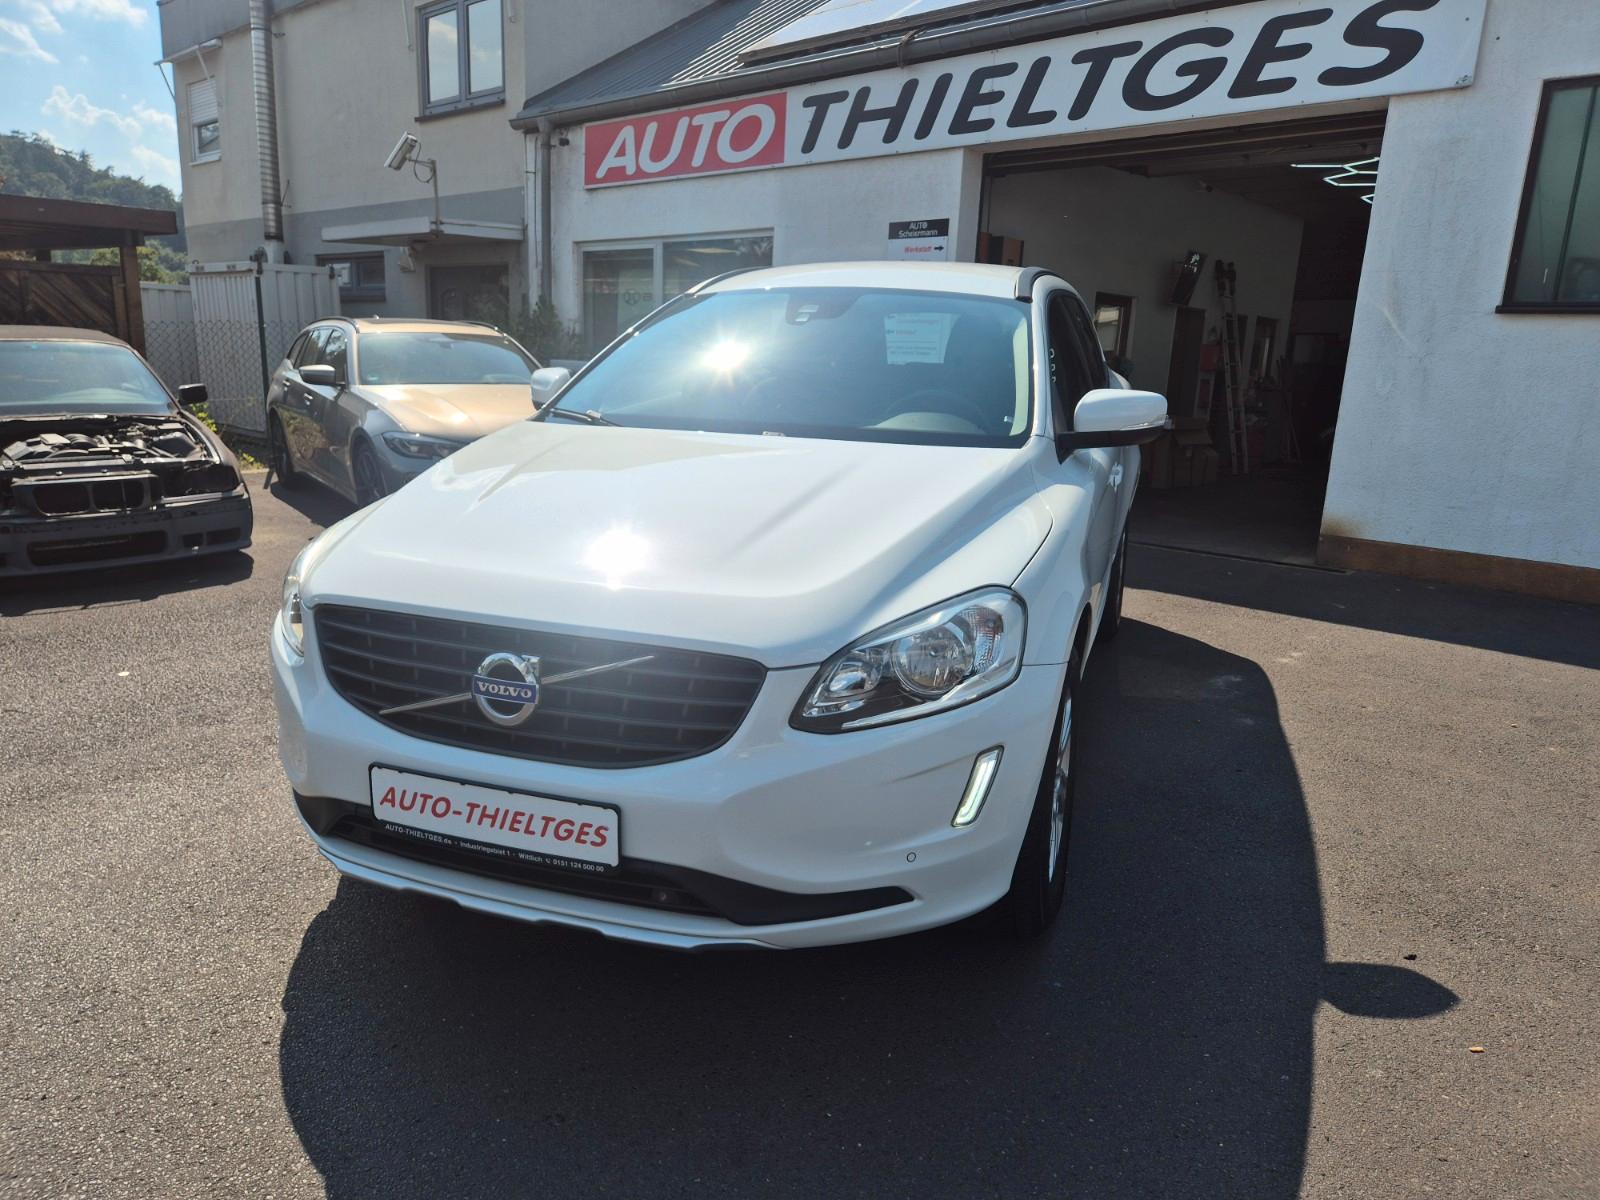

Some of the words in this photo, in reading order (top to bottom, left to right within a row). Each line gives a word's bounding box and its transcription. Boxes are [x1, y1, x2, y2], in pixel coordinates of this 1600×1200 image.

[595, 103, 776, 180] AUTO
[800, 0, 1441, 155] THIELTGES
[908, 221, 928, 230] AUTO
[476, 680, 532, 699] VOLVO
[379, 786, 609, 848] AUTO-THIELTGES
